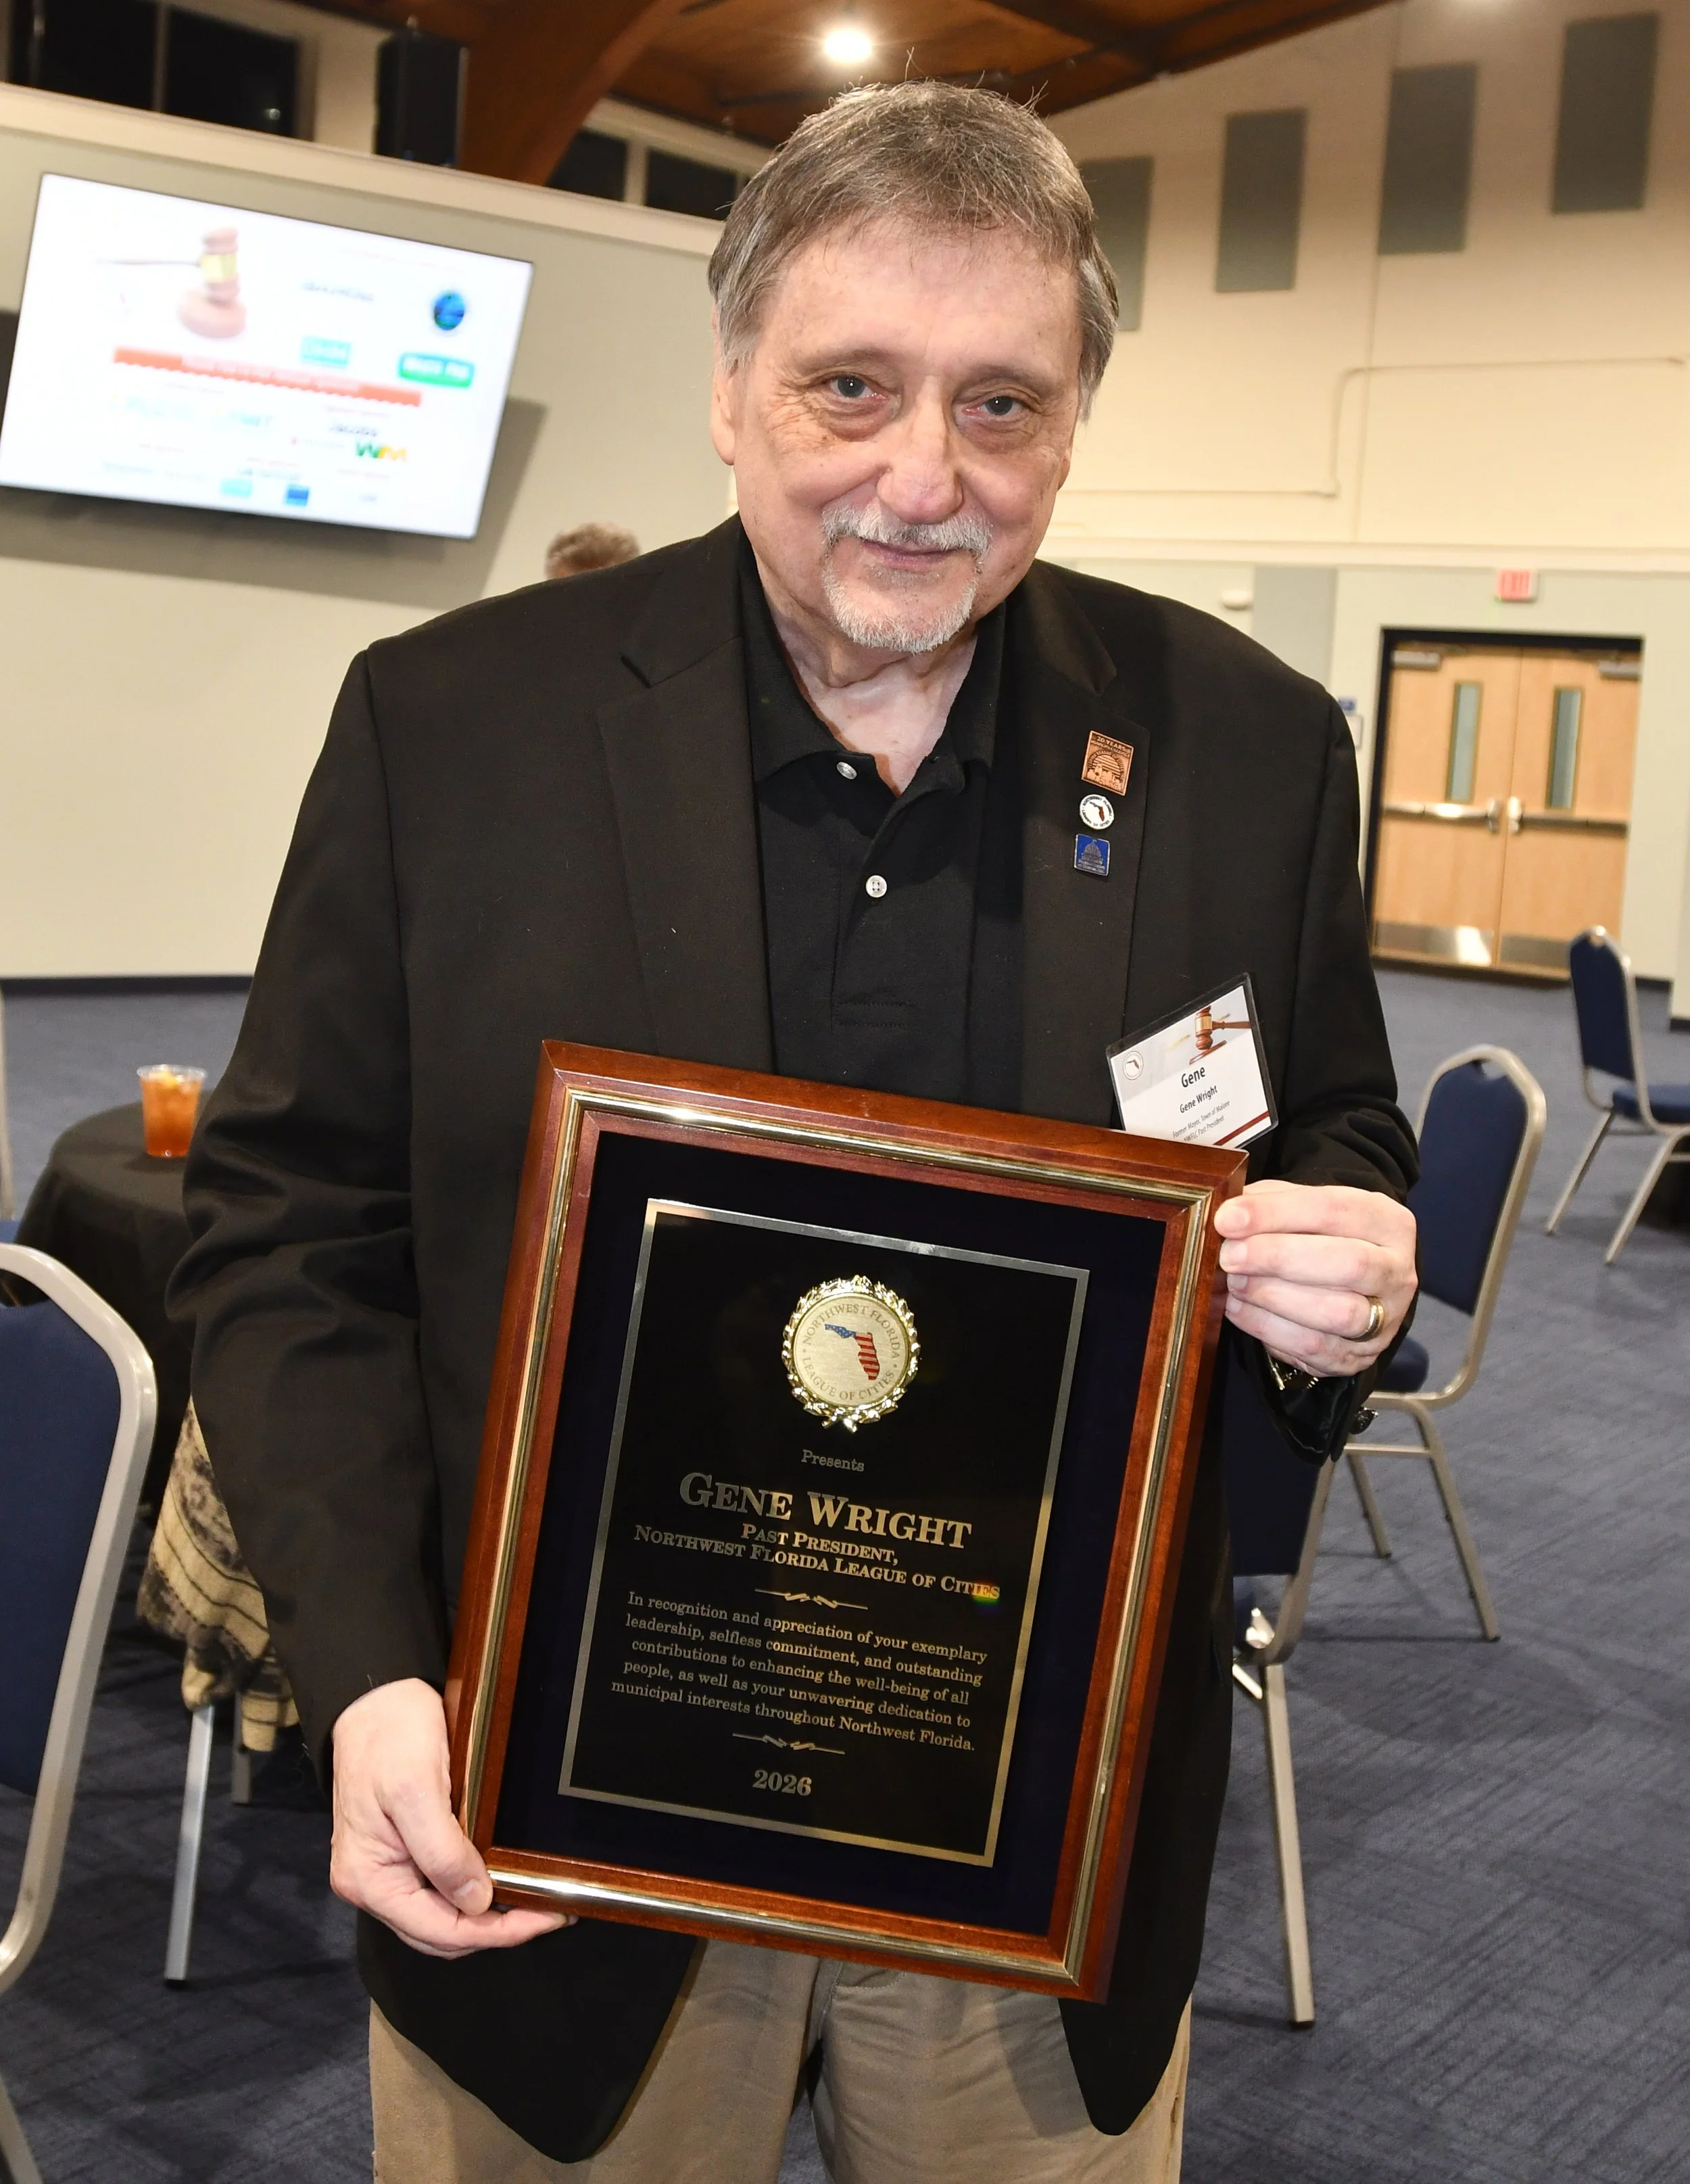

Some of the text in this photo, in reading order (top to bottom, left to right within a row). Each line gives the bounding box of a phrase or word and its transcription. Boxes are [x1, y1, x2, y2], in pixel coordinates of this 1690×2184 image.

[1106, 740, 1127, 751] YEARS
[1181, 1067, 1205, 1087] Gene
[1180, 1085, 1217, 1114] Gene Wright
[1172, 1126, 1187, 1139] Former
[1211, 1107, 1216, 1116] of
[1198, 1126, 1207, 1135] Past
[1207, 1116, 1224, 1129] President
[802, 1303, 900, 1358] NORTHWEST FLORIDA
[802, 1357, 895, 1400] LEAGUE OF CITIES
[800, 1449, 865, 1472] Presents
[679, 1472, 973, 1549] GENE WRIGHT
[633, 1525, 1000, 1600] NORTHWEST FLORIDA LEAGUE OF CITIES
[740, 1523, 898, 1567] PAST PRESIDENT,
[627, 1591, 988, 1665] In recognition and appreciation of your exemplary
[625, 1613, 984, 1688] leadership, selfless commitment, and outstanding
[631, 1640, 969, 1705] contributions to enhancing the well-being of all
[611, 1682, 975, 1751] municipal interests throughout Northwest Florida.
[623, 1661, 971, 1728] people, as well as your unwavering dedication to
[752, 1770, 813, 1796] 2026
